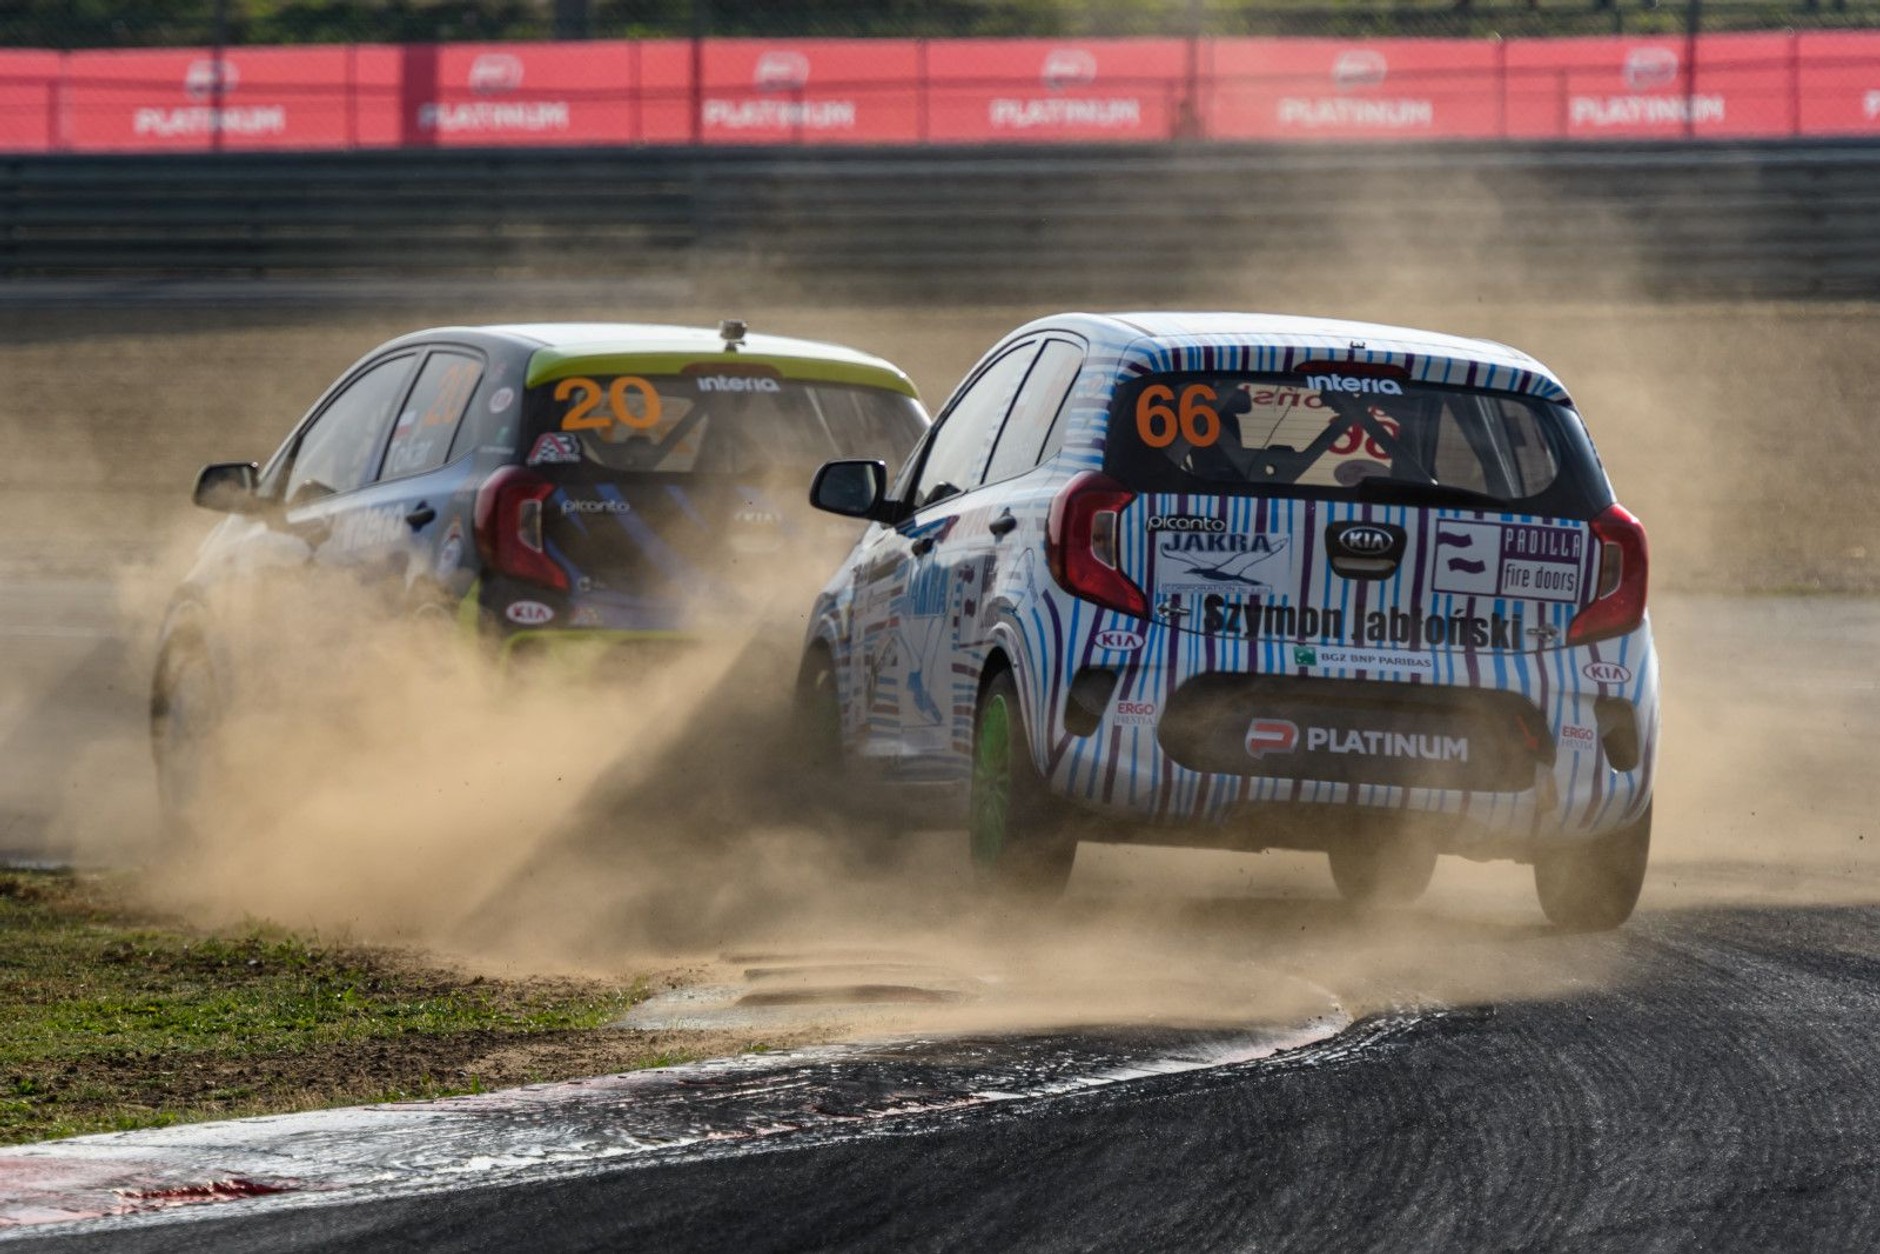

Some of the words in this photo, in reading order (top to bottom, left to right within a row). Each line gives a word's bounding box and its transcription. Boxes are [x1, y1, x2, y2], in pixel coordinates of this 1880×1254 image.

[133, 105, 285, 134] PLATINUM
[418, 101, 570, 130] PLATINUM
[703, 98, 855, 126] PLATINUM
[990, 97, 1140, 126] PLATINUM
[1278, 97, 1433, 126] PLATINUM
[1569, 94, 1725, 125] PLATINUM
[1306, 374, 1403, 396] interia
[555, 376, 662, 431] 20
[1135, 383, 1221, 448] 66
[560, 498, 632, 517] picanto
[1147, 514, 1228, 533] picanto
[1351, 531, 1384, 549] KIA
[1505, 527, 1581, 558] PADILLA
[1503, 563, 1530, 590] fire
[1535, 566, 1575, 591] doors
[510, 605, 547, 621] KIA
[1203, 594, 1342, 639] Szymon
[1102, 632, 1136, 647] KIA
[1350, 655, 1375, 663] BNP
[1379, 656, 1432, 668] PARIBAS
[1591, 667, 1625, 680] KIA
[1117, 703, 1155, 715] ERGO
[1307, 728, 1468, 762] PLATINUM
[1563, 726, 1594, 740] ERGO
